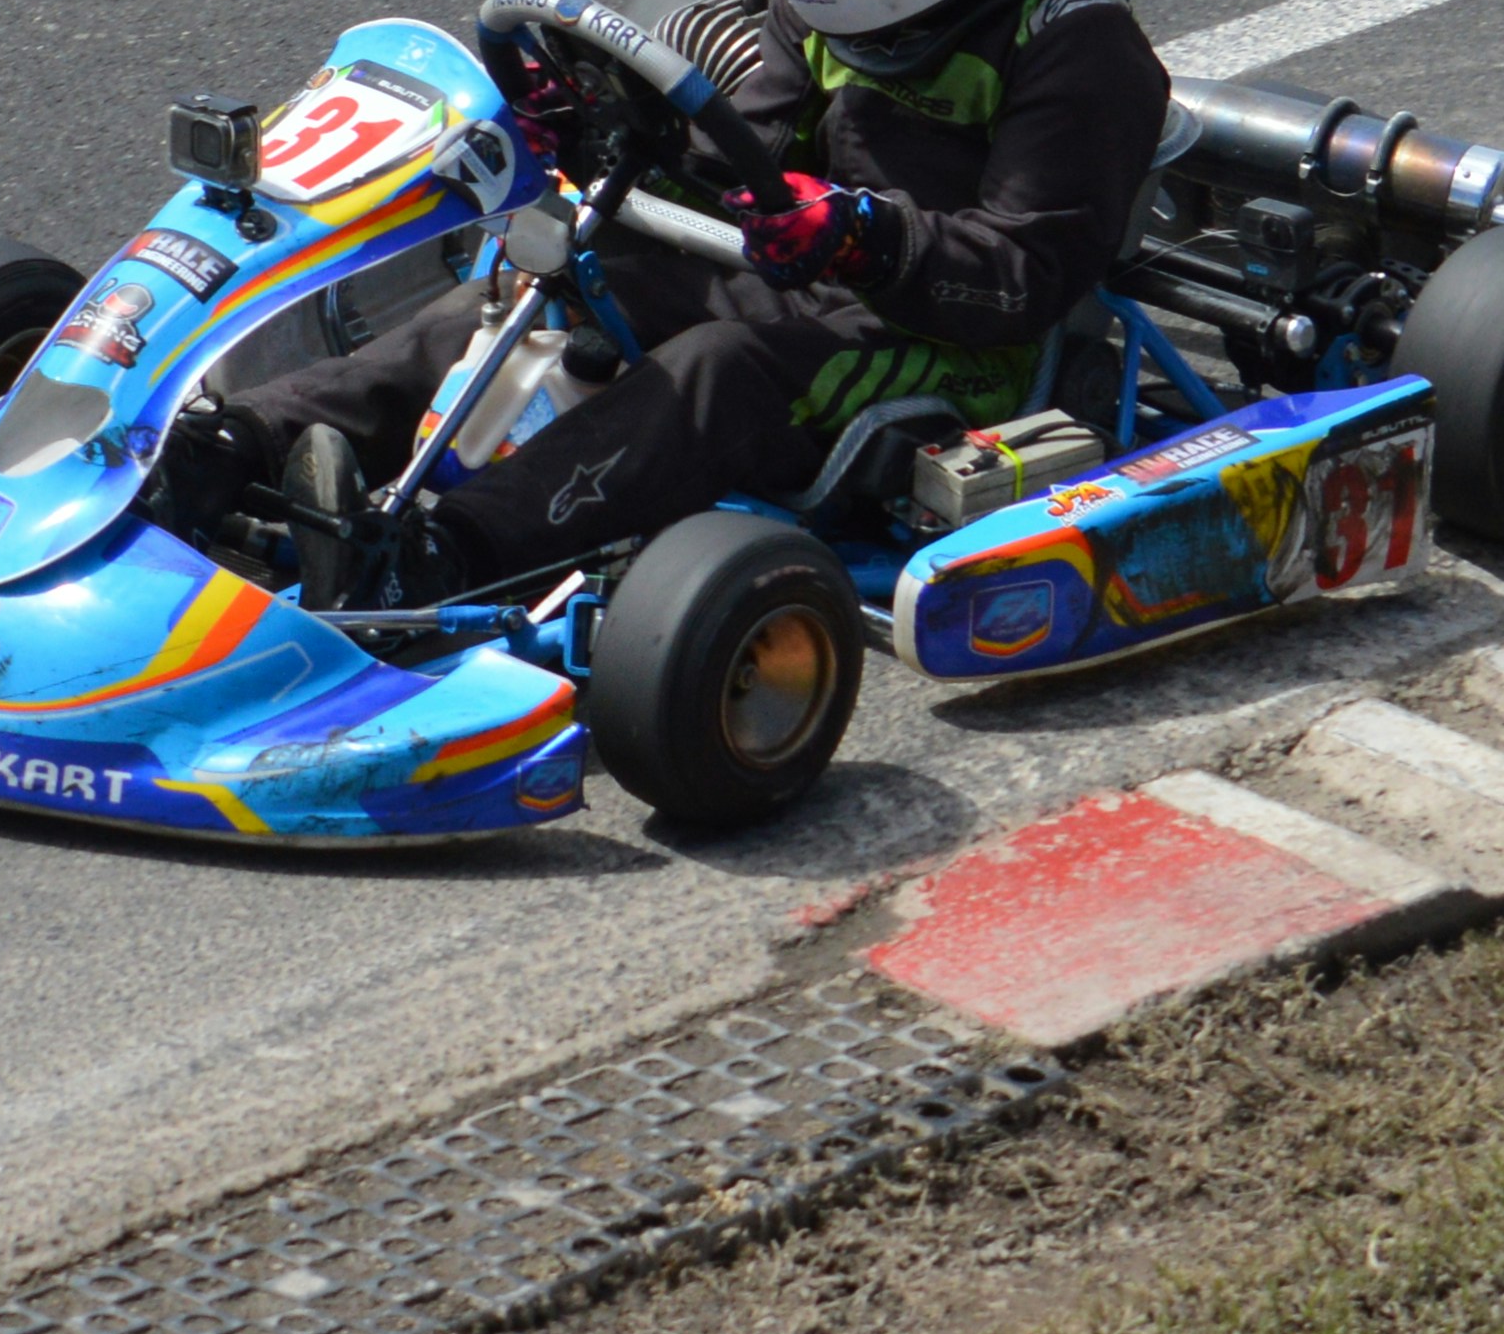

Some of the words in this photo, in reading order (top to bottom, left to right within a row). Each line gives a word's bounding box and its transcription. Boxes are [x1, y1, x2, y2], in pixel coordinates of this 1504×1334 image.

[588, 9, 653, 57] KART
[261, 96, 404, 190] 31
[146, 234, 227, 282] RACE
[1160, 427, 1241, 462] RACE
[1314, 440, 1417, 591] 31
